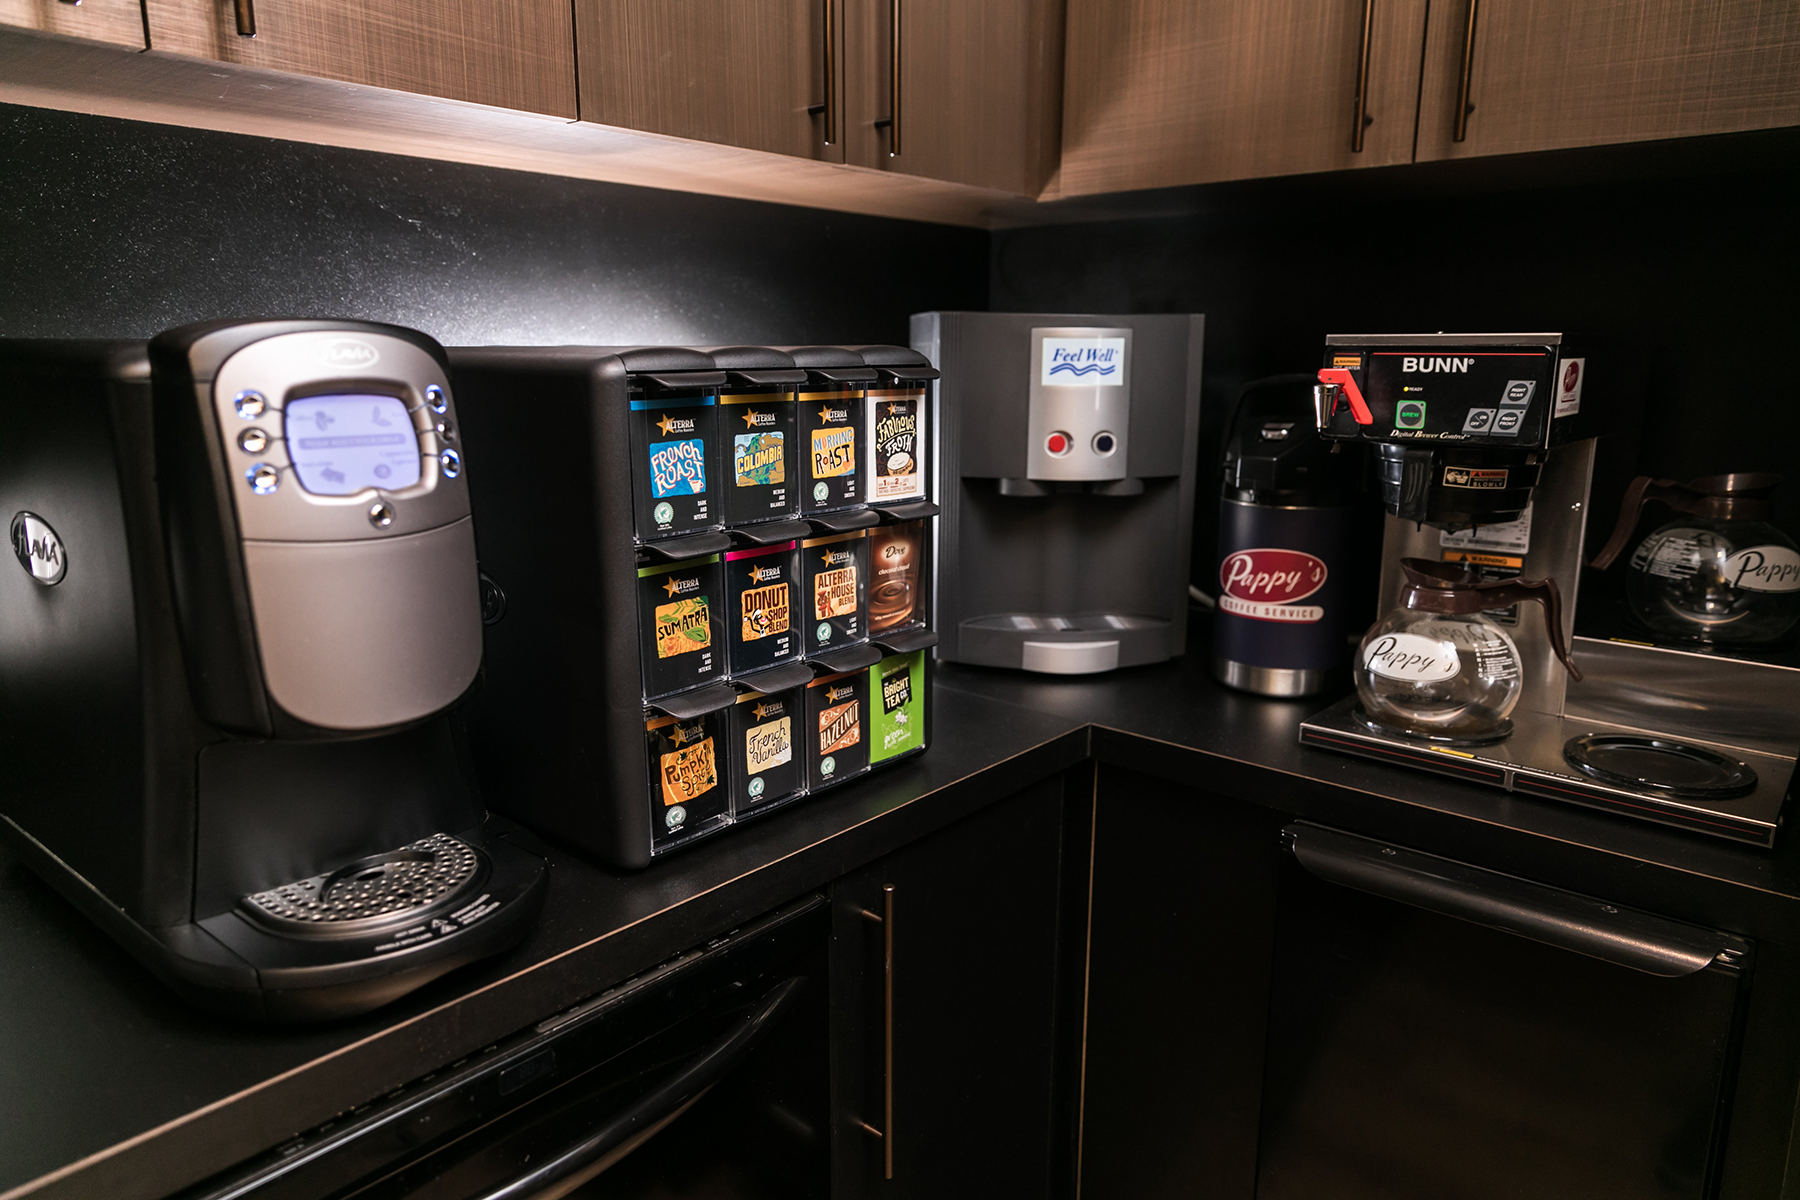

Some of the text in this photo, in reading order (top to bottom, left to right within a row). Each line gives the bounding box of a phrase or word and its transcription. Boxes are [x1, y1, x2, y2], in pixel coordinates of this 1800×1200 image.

[1052, 348, 1114, 362] Feel Well
[750, 413, 776, 423] ALTERRA
[825, 410, 847, 419] ALTERRA
[666, 418, 694, 430] ALTERRA
[876, 415, 915, 443] FABULOUS
[813, 429, 853, 452] MORNING
[1390, 429, 1466, 440] Digital Brewer Control
[885, 434, 913, 457] FROTH
[736, 445, 783, 474] COLOMBIA
[815, 444, 850, 475] ROAST
[653, 460, 704, 496] ROAST
[828, 551, 850, 561] ALTERRA
[756, 567, 781, 579] ALTERRA
[818, 569, 854, 589] ALTERRA
[1224, 554, 1321, 595] Pappy's
[672, 578, 699, 592] ALTERRA
[831, 582, 854, 599] HOUSE
[744, 586, 787, 614] DONUT
[838, 595, 855, 607] BLEND
[1223, 599, 1315, 619] COFFEE SERVICE
[768, 605, 787, 621] SHOP
[658, 607, 708, 641] SUMATRA
[768, 619, 788, 633] BLEND
[832, 686, 854, 698] ALTERRA
[883, 676, 909, 698] BRIGHT
[760, 701, 783, 714] ALTERRA
[885, 695, 901, 709] TEA
[820, 702, 859, 751] HAZELNUT
[749, 722, 787, 754] French
[752, 737, 789, 765] Vanilla
